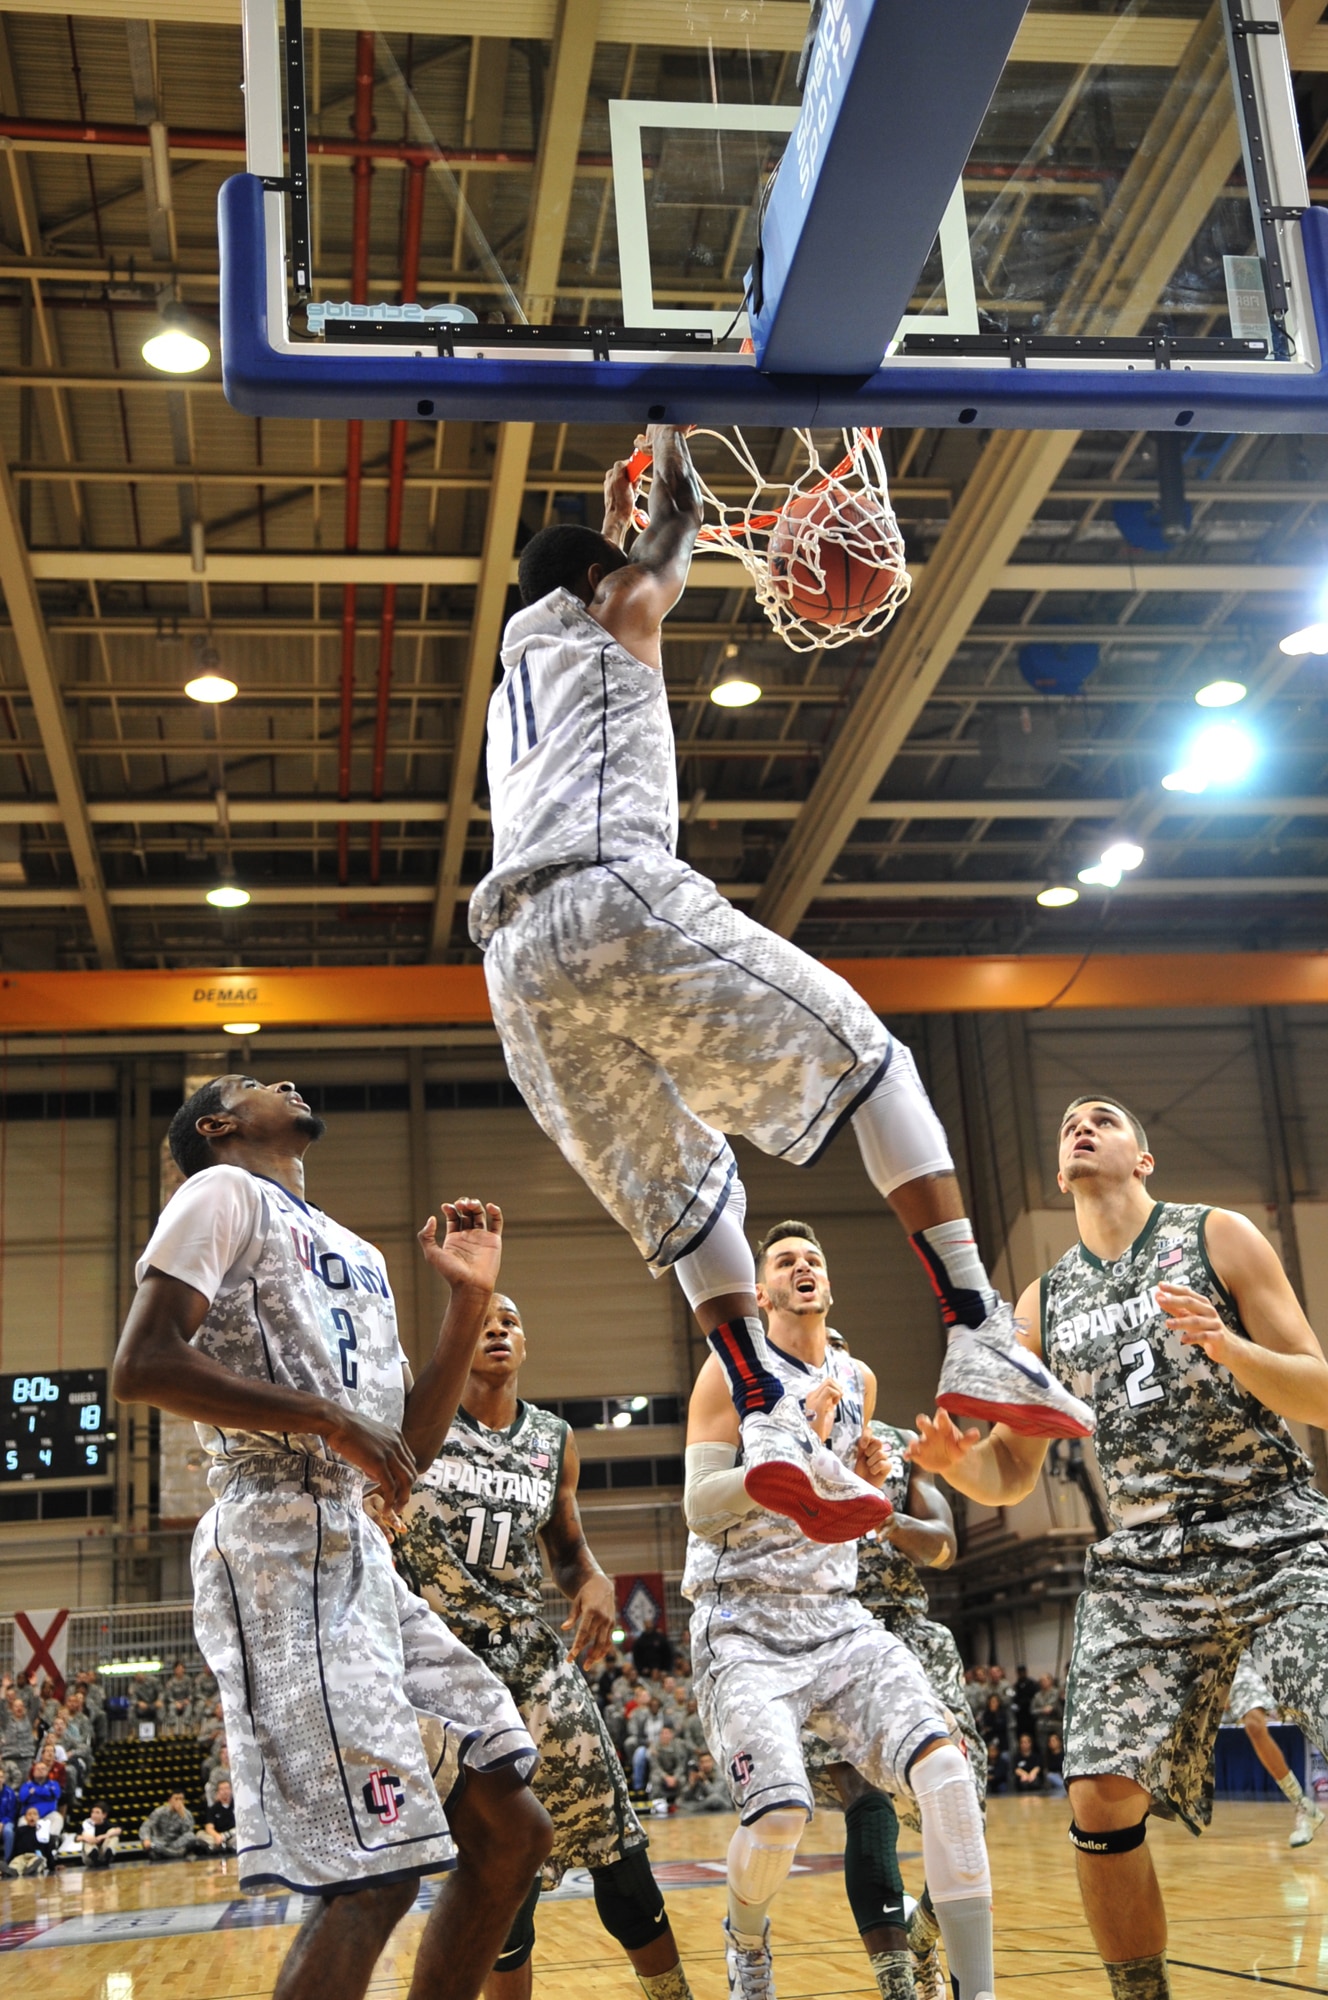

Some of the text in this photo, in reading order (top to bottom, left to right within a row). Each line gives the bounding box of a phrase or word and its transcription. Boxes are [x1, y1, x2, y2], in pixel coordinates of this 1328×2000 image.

[799, 13, 852, 200] sports
[193, 988, 258, 1002] DEMAG
[331, 1308, 358, 1390] 2
[1118, 1338, 1165, 1408] 2
[28, 1416, 36, 1432] 1
[80, 1405, 101, 1430] 18
[6, 1450, 18, 1470] 5
[39, 1449, 52, 1466] 4
[86, 1445, 98, 1465] 5
[424, 1458, 552, 1508] SPARTANS
[465, 1506, 513, 1570] 11
